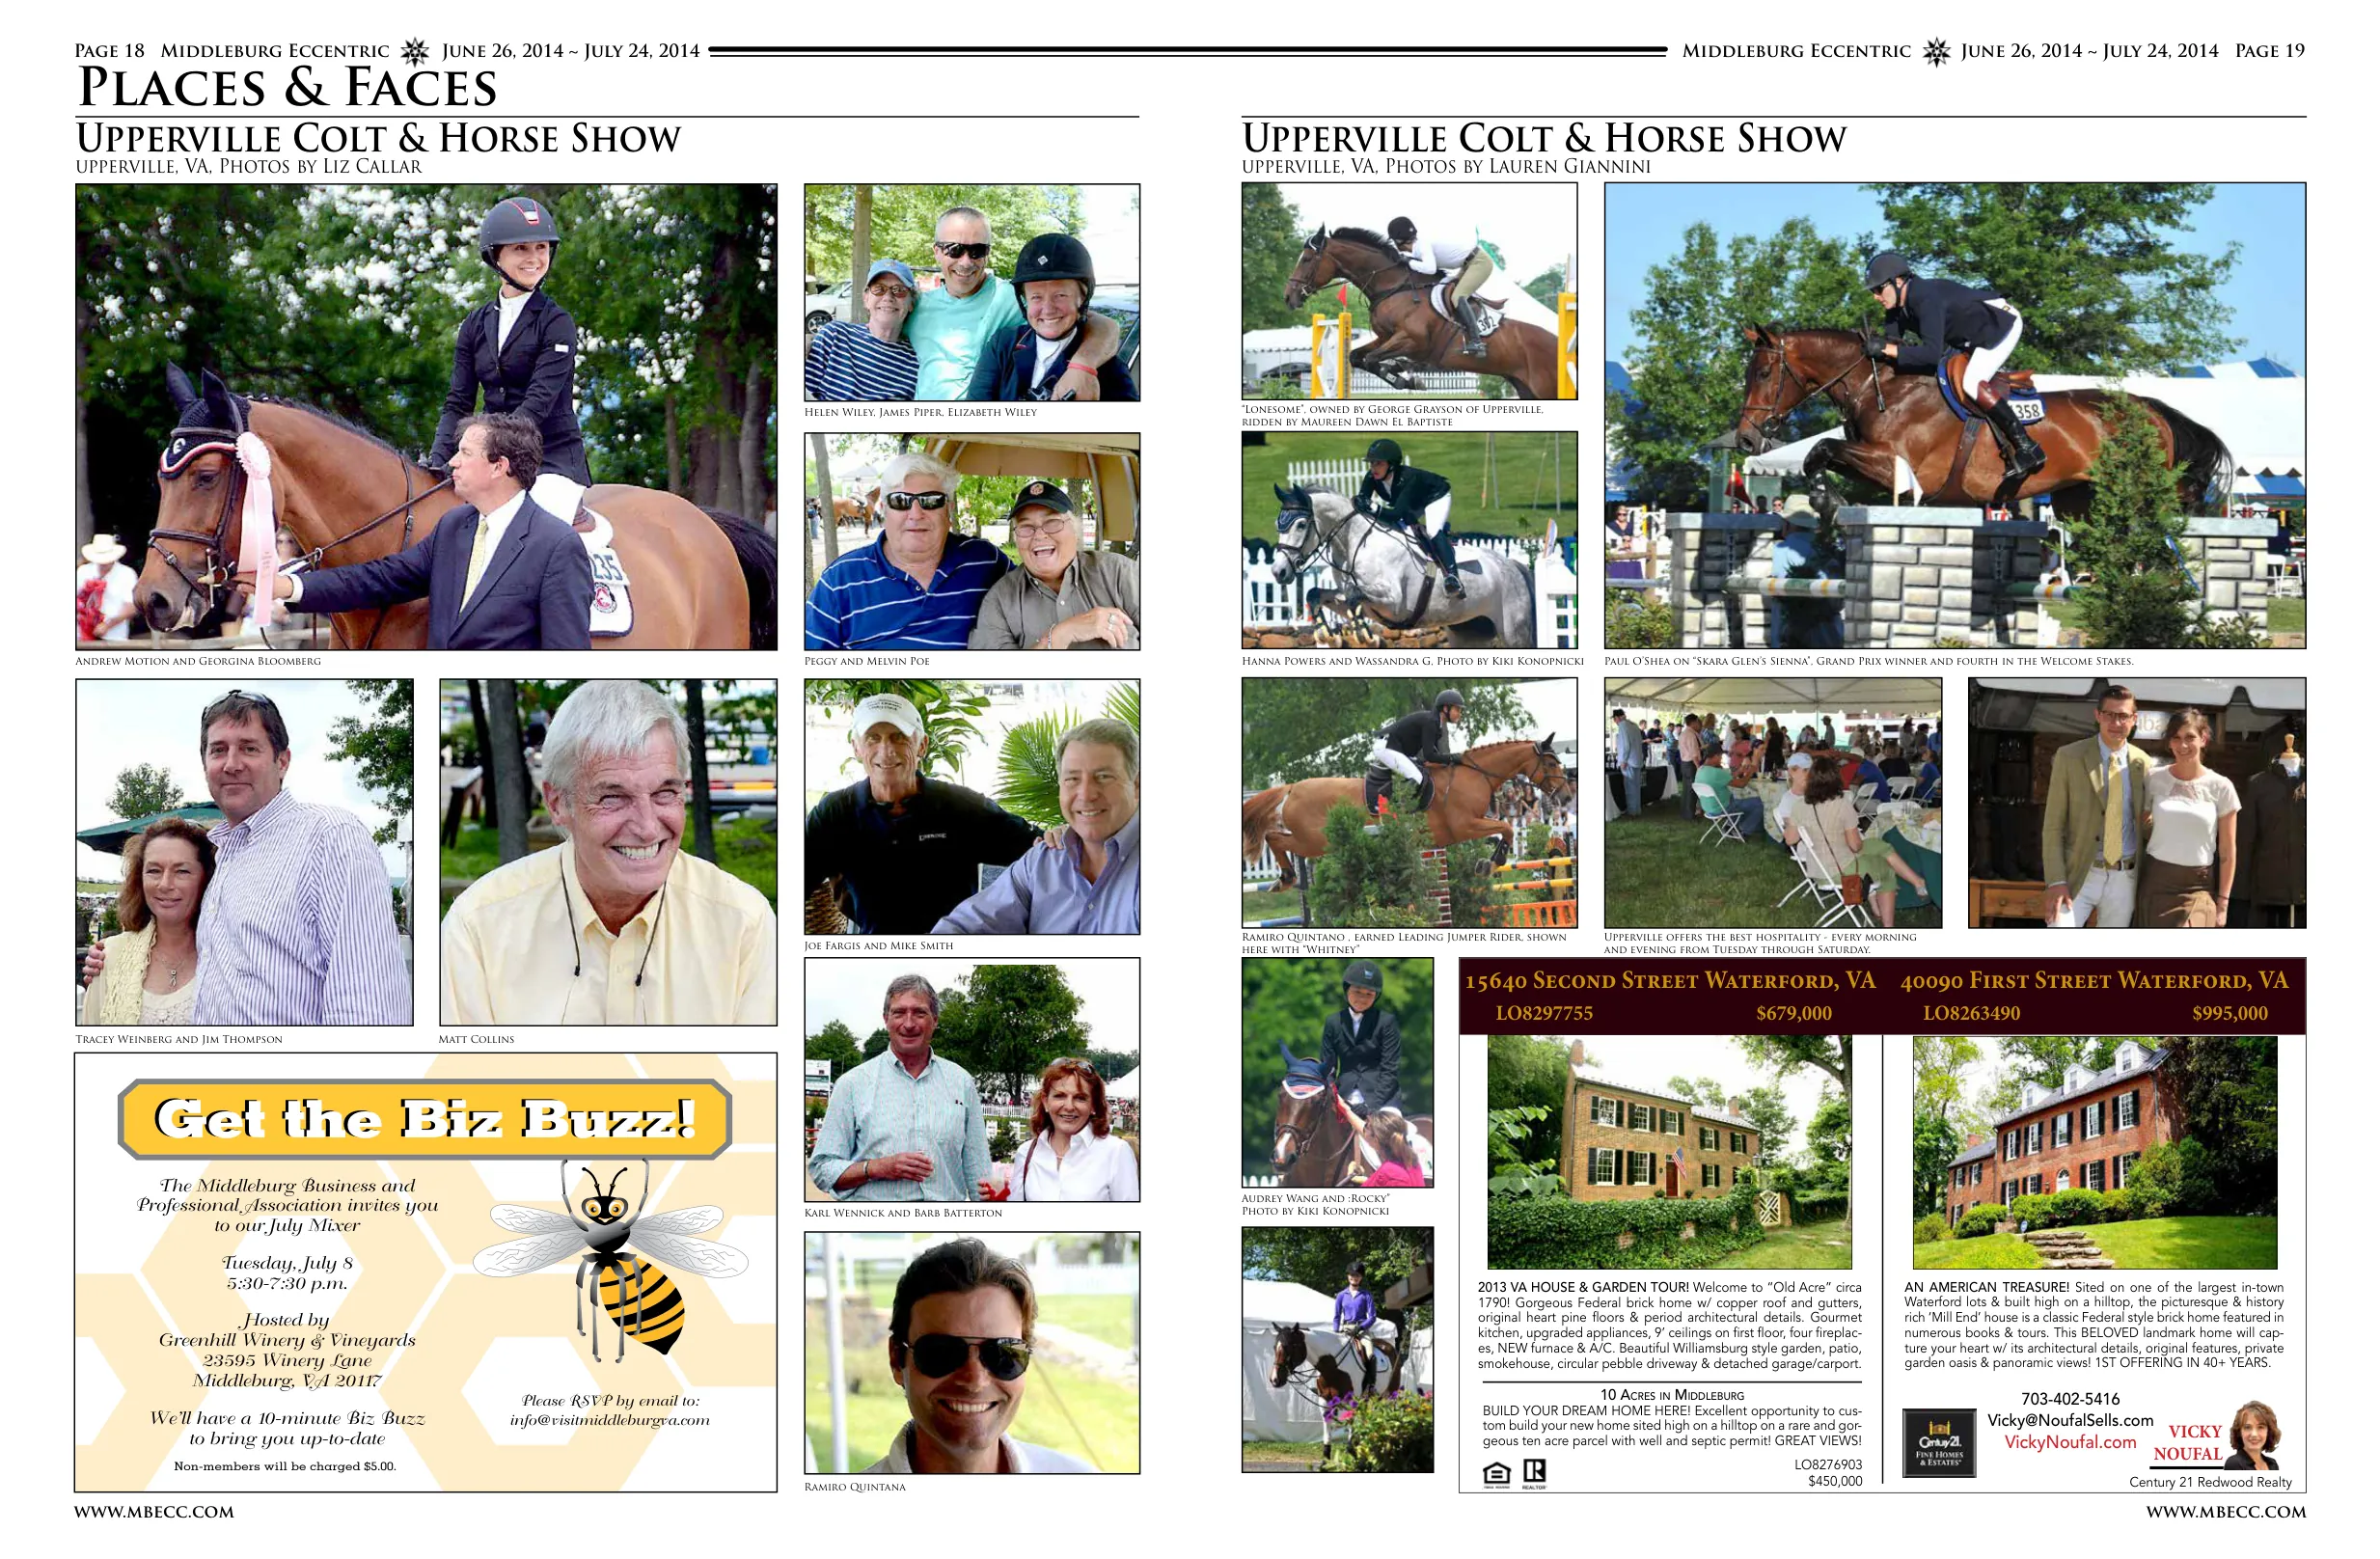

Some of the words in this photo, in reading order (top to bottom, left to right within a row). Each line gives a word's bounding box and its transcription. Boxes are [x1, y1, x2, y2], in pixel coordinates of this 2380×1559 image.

[442, 42, 486, 62] JUNE
[522, 42, 564, 58] 2014
[584, 42, 624, 62] JULY
[658, 42, 700, 58] 2014
[1961, 42, 2006, 62] JUNE
[2040, 42, 2083, 58] 2014
[2103, 42, 2143, 62] JULY
[2177, 42, 2220, 58] 2014
[2235, 42, 2280, 58] PAGE
[2286, 42, 2306, 58] 19
[78, 65, 265, 107] PLACES
[285, 65, 331, 107] &
[344, 65, 497, 107] FACES
[75, 122, 281, 153] UPPERVILLE
[293, 122, 388, 153] COLT
[398, 122, 430, 153] &
[438, 122, 559, 153] HORSE
[572, 122, 682, 153] SHOW
[1242, 122, 1447, 153] UPPERVILLE
[1459, 122, 1554, 153] COLT
[1565, 122, 1597, 153] &
[1604, 122, 1725, 153] HORSE
[1738, 122, 1847, 153] SHOW
[1465, 971, 1527, 993] 15640
[1533, 970, 1616, 989] SECOND
[1622, 970, 1699, 989] STREET
[1845, 970, 1877, 989] VA
[1900, 975, 1963, 993] 40090
[1969, 970, 2030, 989] FIRST
[2035, 970, 2112, 989] STREET
[2257, 970, 2290, 989] VA
[1495, 1004, 1594, 1021] LO8297755
[1756, 1004, 1833, 1024] $679,000
[1923, 1004, 2021, 1021] LO8263490
[2192, 1004, 2269, 1024] $995,000
[154, 1098, 265, 1139] Get
[283, 1098, 382, 1139] the
[400, 1098, 503, 1139] Biz
[521, 1098, 697, 1139] Buzz!
[221, 1254, 297, 1274] Tuesday,
[297, 1254, 338, 1274] July
[342, 1256, 354, 1271] 8
[227, 1276, 307, 1290] 5:30-7:30
[310, 1280, 347, 1294] p.m.
[236, 1312, 304, 1331] Hosted
[308, 1312, 330, 1331] by
[202, 1354, 256, 1368] 23595
[262, 1352, 325, 1371] Winery
[329, 1353, 372, 1370] Lane
[1478, 1356, 1554, 1371] smokehouse,
[1557, 1356, 1600, 1369] circular
[1601, 1356, 1643, 1373] pebble
[1646, 1356, 1698, 1372] driveway
[1701, 1357, 1710, 1369] &
[1713, 1356, 1768, 1369] detached
[1771, 1356, 1862, 1373] garage/carport.
[2021, 1391, 2120, 1406] 703-402-5416
[510, 1413, 710, 1430] info@visitmiddleburgva.com
[1987, 1412, 2154, 1431] Vicky@NoufalSells.com
[2168, 1425, 2223, 1438] VICKY
[2004, 1434, 2137, 1454] VickyNoufal.com
[2153, 1446, 2224, 1461] NOUFAL
[174, 1461, 260, 1471] Non-members
[263, 1461, 287, 1471] will
[290, 1461, 307, 1471] be
[310, 1461, 361, 1474] charged
[364, 1461, 397, 1472] $5.00.
[1794, 1459, 1863, 1470] LO8276903
[1808, 1474, 1863, 1489] $450,000
[2129, 1476, 2176, 1491] Century
[2179, 1476, 2192, 1488] 21
[2198, 1476, 2254, 1488] Redwood
[2257, 1475, 2293, 1491] Realty
